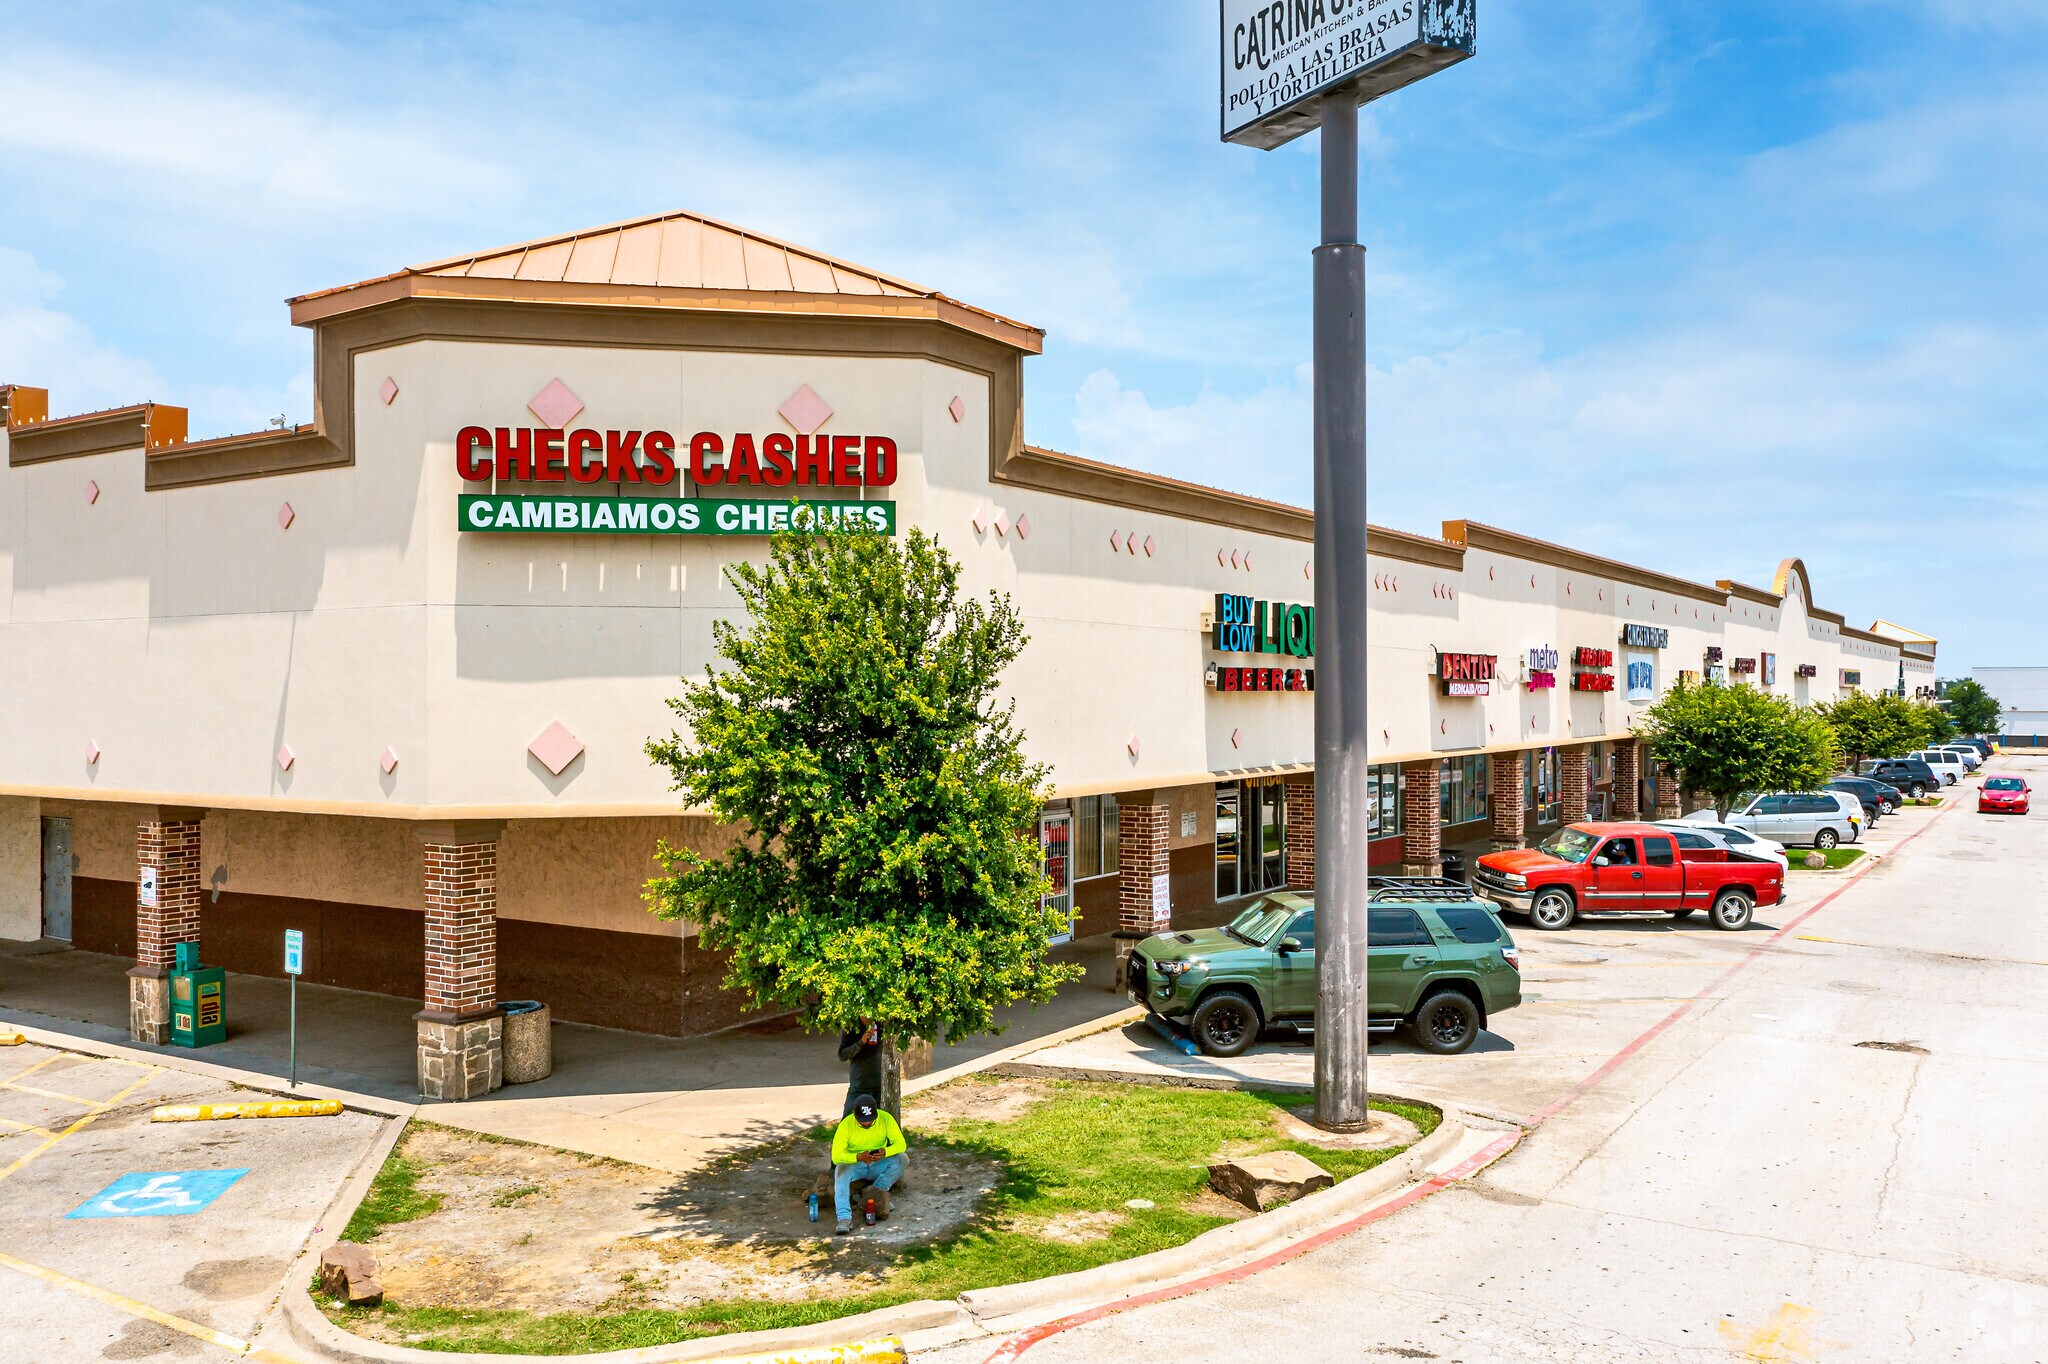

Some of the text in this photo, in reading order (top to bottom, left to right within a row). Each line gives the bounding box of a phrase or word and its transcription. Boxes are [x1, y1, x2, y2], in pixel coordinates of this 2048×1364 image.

[1234, 0, 1325, 70] CATRINA
[1272, 36, 1311, 63] MEXICAN
[1314, 13, 1354, 40] KITCHEN
[1357, 6, 1364, 17] &
[1230, 72, 1279, 111] POLLO
[1284, 64, 1296, 82] A
[1301, 42, 1333, 73] LAS
[1339, 1, 1412, 54] BRASAS
[1254, 37, 1386, 116] Y TORTILLERIA
[456, 426, 898, 487] CHECKS CASHED
[468, 500, 888, 532] CAMBIAMOS CHEQUES
[1222, 593, 1254, 624] BUY
[1220, 623, 1255, 652] LOW
[1443, 653, 1497, 679] DENTIST
[1530, 644, 1558, 669] metro
[1225, 668, 1305, 691] BEER &
